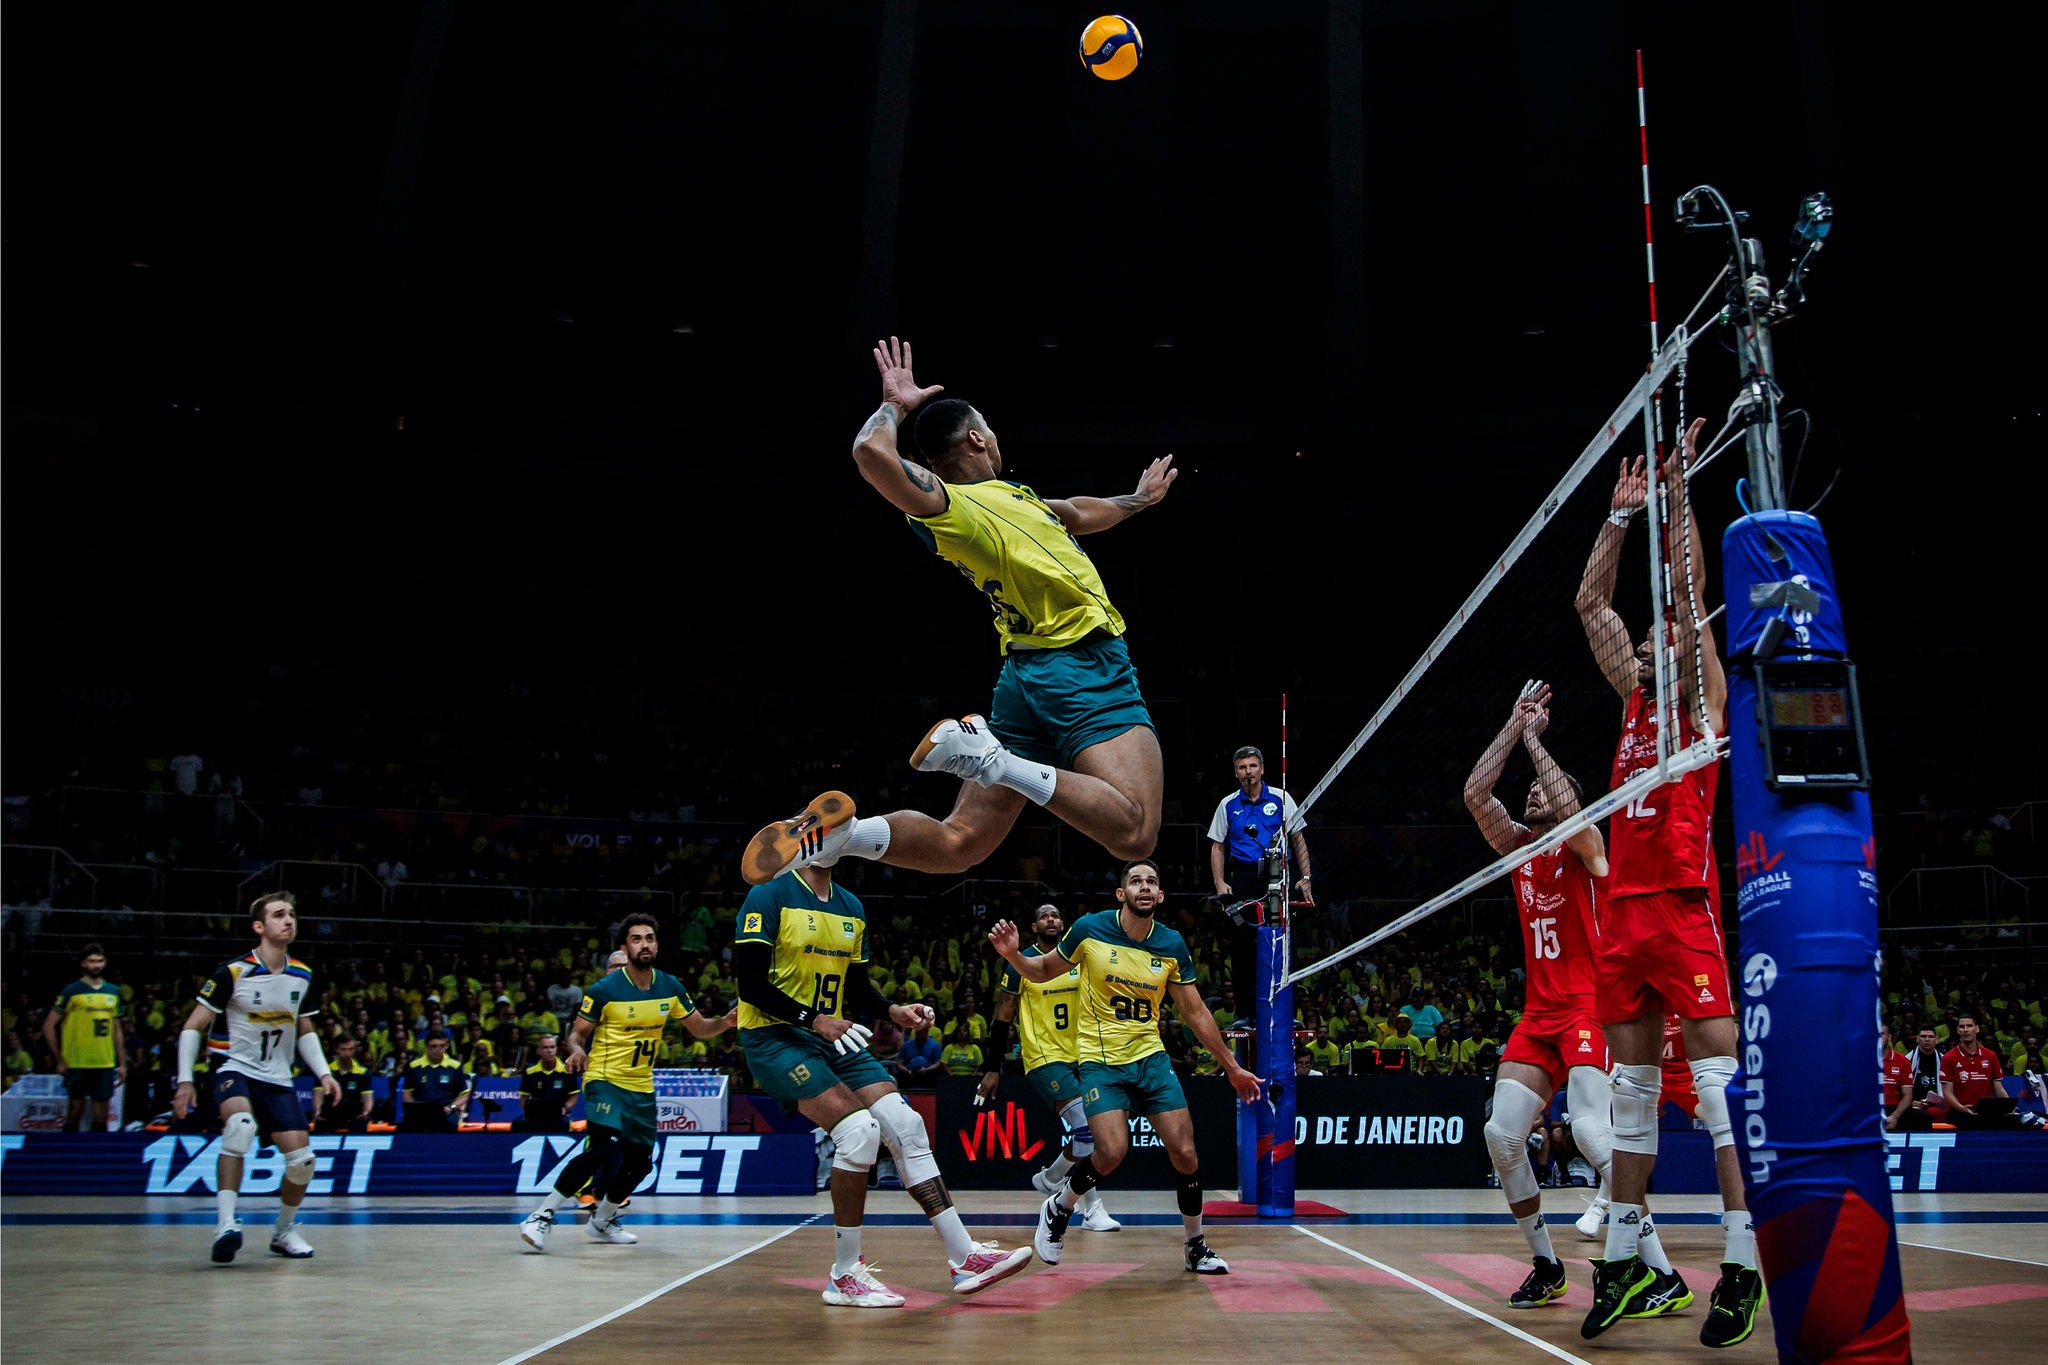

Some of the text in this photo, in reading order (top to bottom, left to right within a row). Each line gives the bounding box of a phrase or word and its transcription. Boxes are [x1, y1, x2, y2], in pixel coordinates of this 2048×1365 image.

[1529, 917, 1561, 960] 15
[812, 971, 842, 1016] 19
[1053, 1003, 1069, 1030] 9
[261, 1028, 284, 1062] 17
[631, 1040, 658, 1068] 14
[788, 1063, 812, 1085] 19
[1743, 1002, 1778, 1184] Senoh
[1315, 1116, 1350, 1145] DE
[1355, 1116, 1464, 1145] JANEIRO
[142, 1135, 394, 1194] 1XBET
